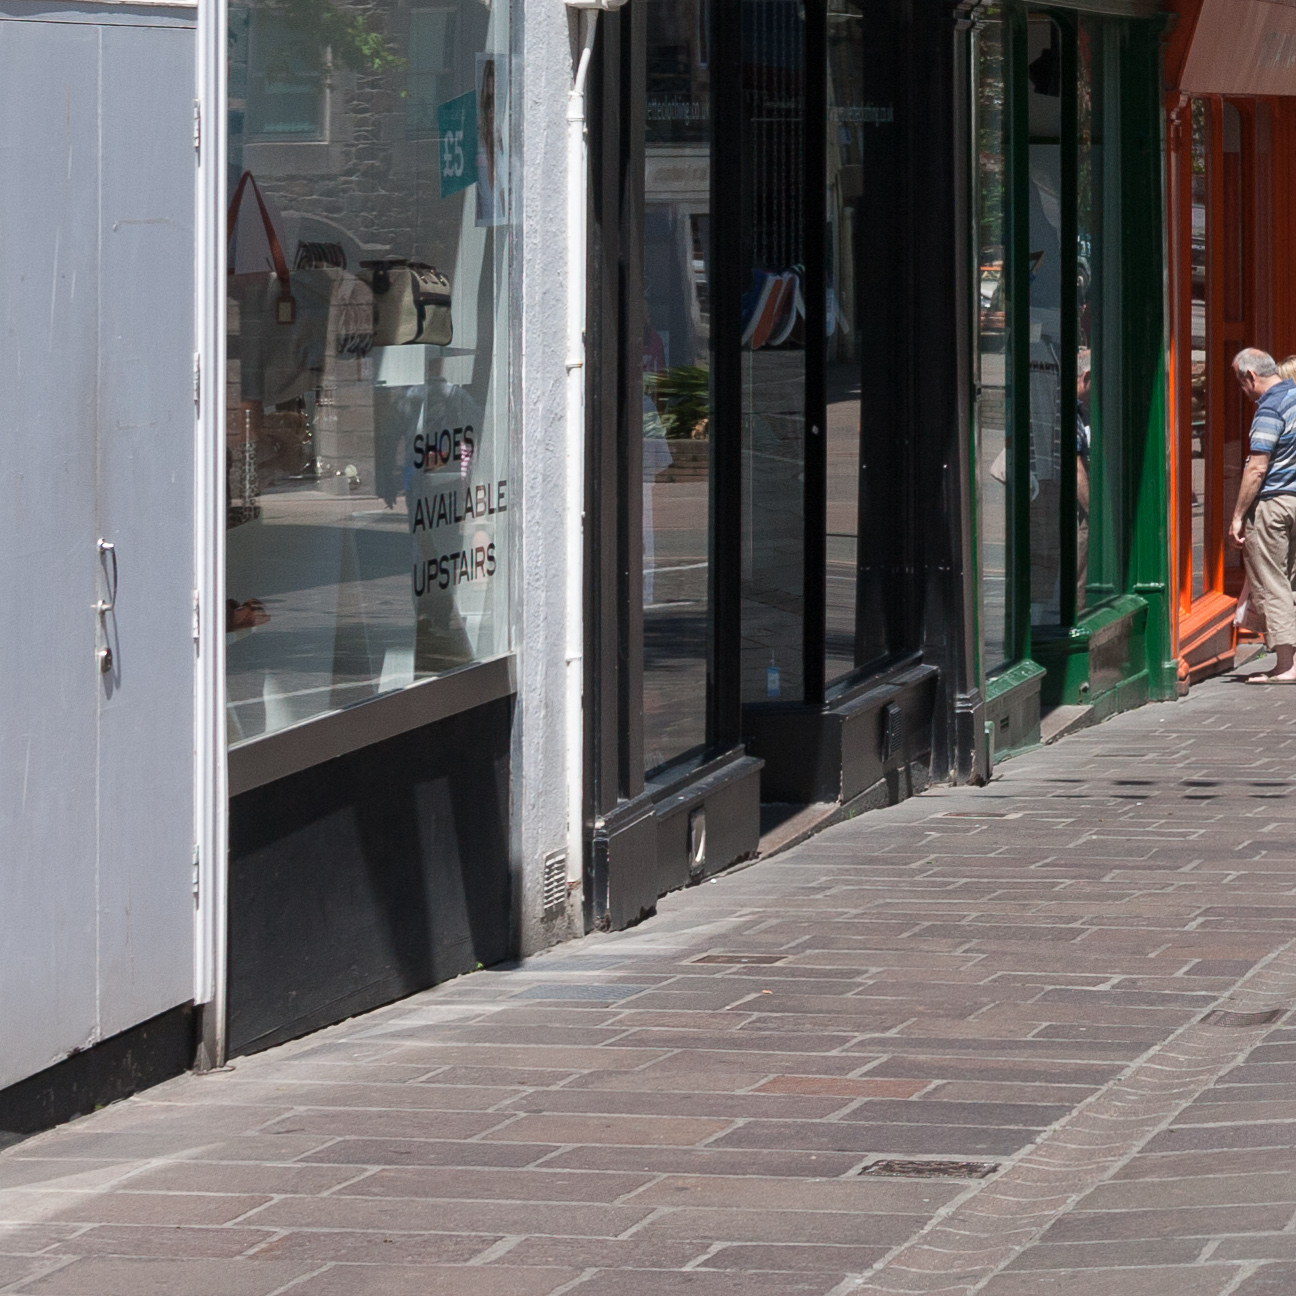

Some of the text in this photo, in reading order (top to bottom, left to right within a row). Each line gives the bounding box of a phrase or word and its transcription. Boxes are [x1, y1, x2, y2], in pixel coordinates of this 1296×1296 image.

[443, 130, 465, 179] £5
[413, 424, 475, 471] SHOES
[412, 479, 508, 535] AVAILABLE
[413, 542, 497, 597] UPSTAIRS
